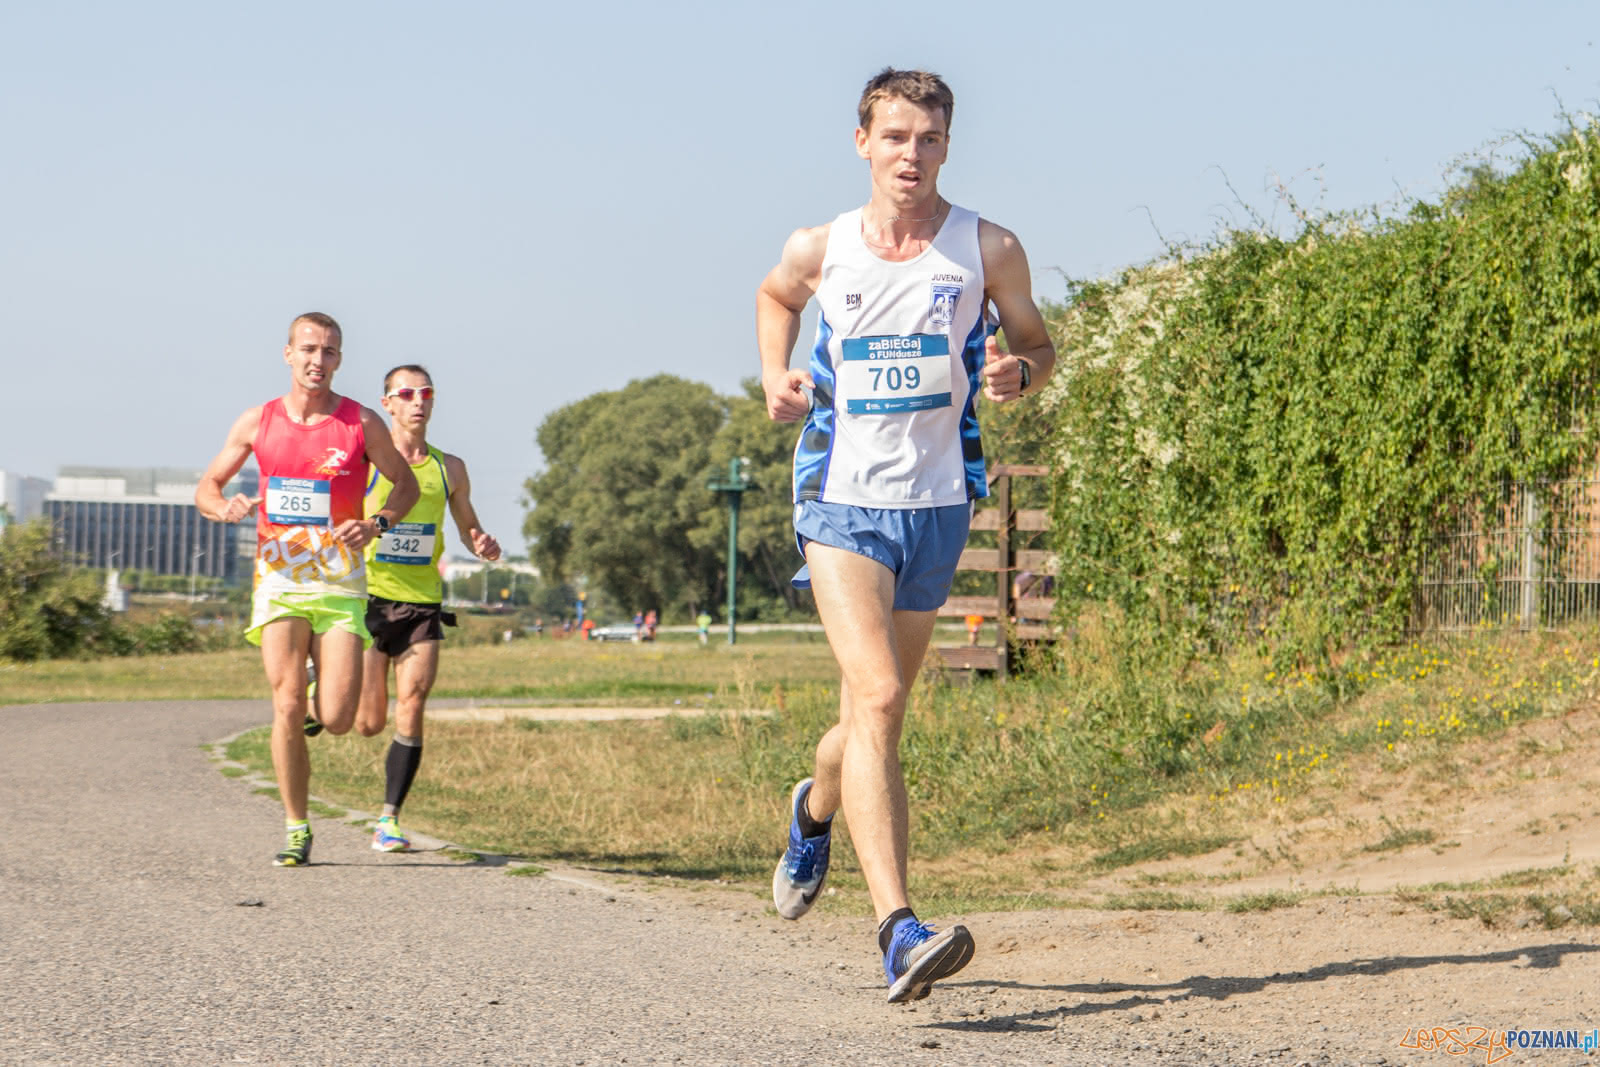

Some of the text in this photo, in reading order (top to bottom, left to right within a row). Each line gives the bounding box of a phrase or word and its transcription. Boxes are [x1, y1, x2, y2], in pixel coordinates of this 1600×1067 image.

[931, 273, 964, 284] JUVENIA
[846, 293, 863, 305] BCM
[868, 337, 922, 351] zaBIEGaj
[869, 349, 922, 360] o FUNdusze
[868, 365, 921, 391] 709
[279, 495, 312, 512] 265
[391, 537, 420, 553] 342
